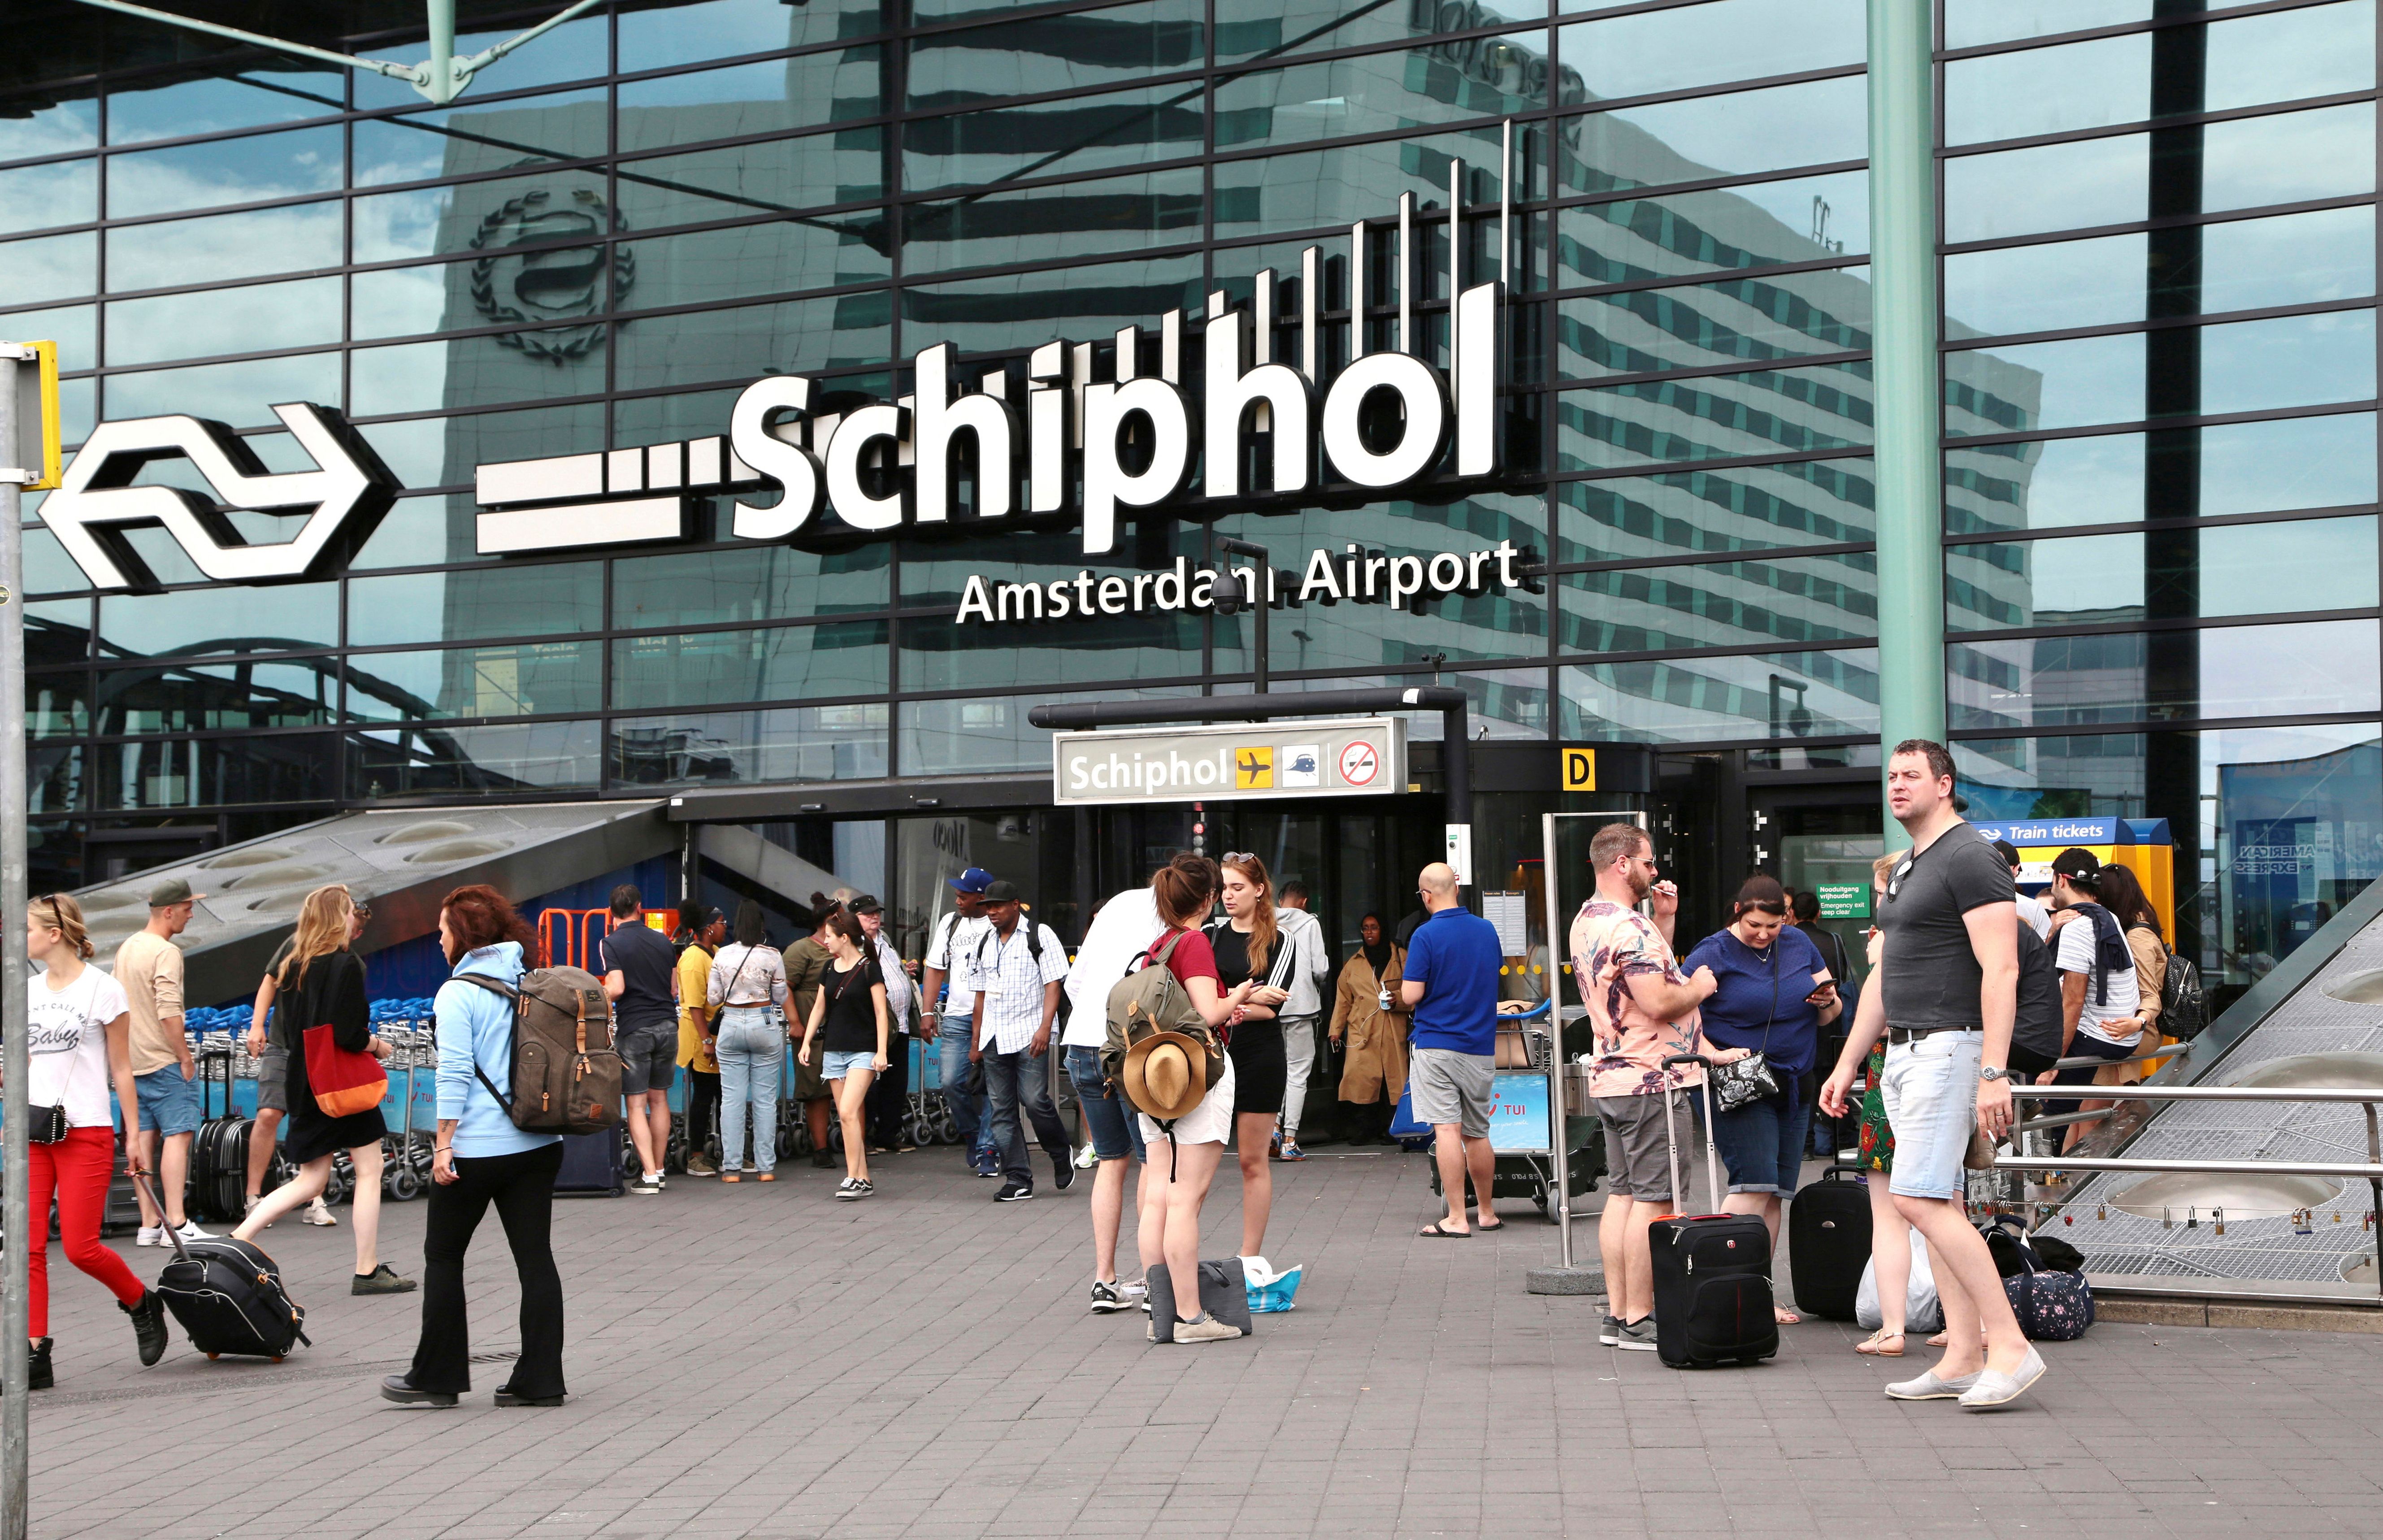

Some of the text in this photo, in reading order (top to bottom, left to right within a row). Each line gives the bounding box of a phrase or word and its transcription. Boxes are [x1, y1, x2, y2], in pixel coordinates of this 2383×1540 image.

[731, 282, 1495, 554] Schiphol
[956, 539, 1519, 625] Amsterdam Airport
[1070, 748, 1228, 794] Schiphol
[1569, 753, 1590, 785] D
[2009, 824, 2103, 840] Train tickets
[51, 1003, 75, 1013] CALL
[28, 1020, 79, 1050] Baby
[928, 1058, 938, 1066] TUI
[421, 1093, 433, 1103] TUI
[1504, 1104, 1526, 1115] TUI
